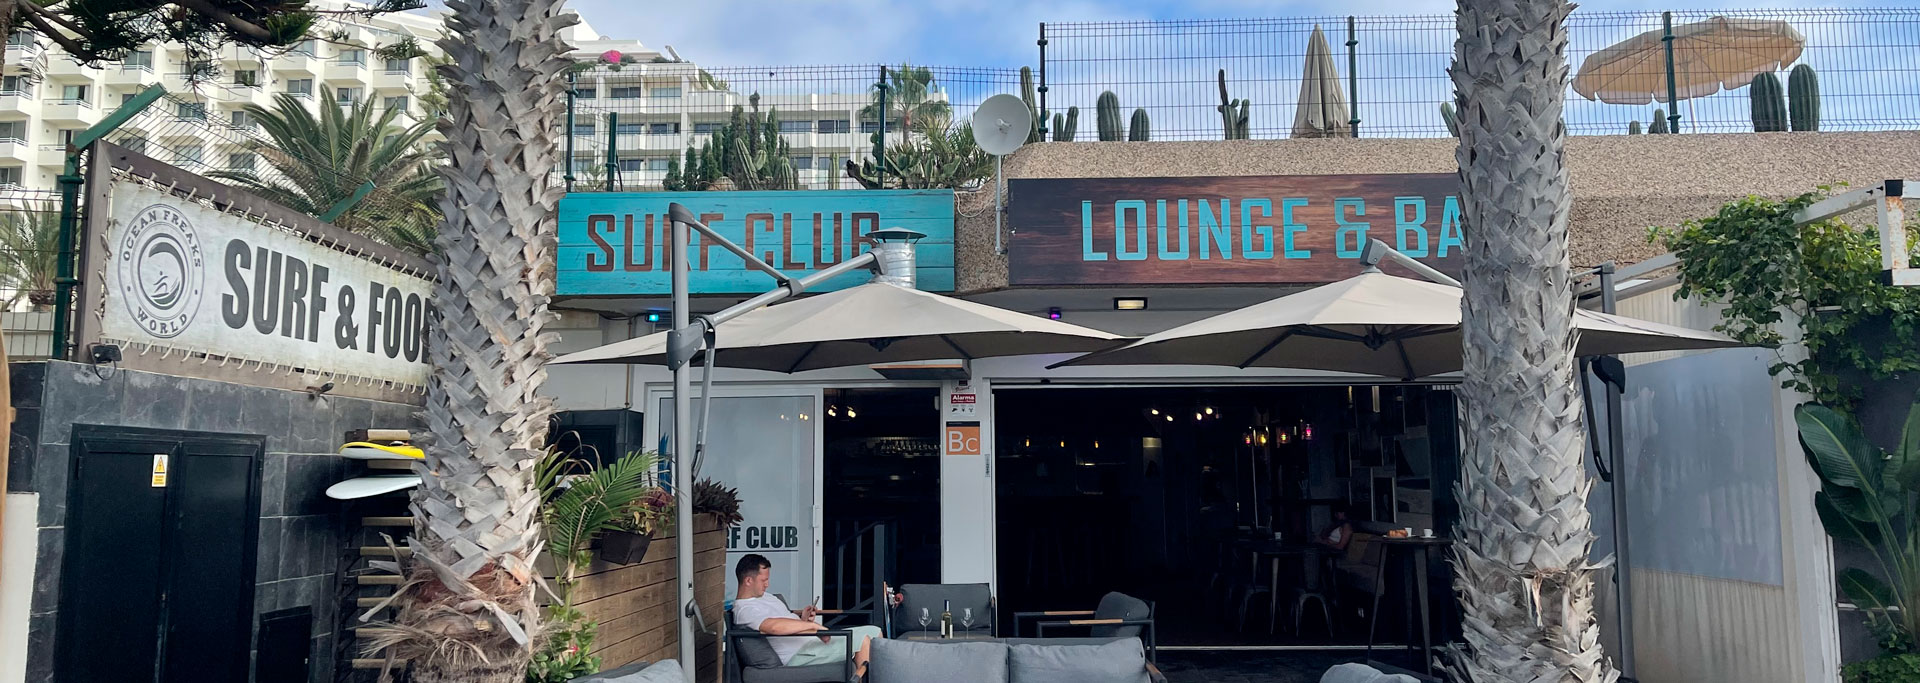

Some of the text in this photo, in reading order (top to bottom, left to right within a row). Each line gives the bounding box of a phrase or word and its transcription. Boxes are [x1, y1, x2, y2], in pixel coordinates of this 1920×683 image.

[123, 209, 201, 268] OCEAN FREAKS
[745, 211, 880, 271] CLUB
[1081, 197, 1311, 261] LOUNGE
[1334, 197, 1371, 259] &
[136, 306, 188, 334] WORLD
[221, 238, 329, 343] SURF
[334, 284, 359, 351] &
[948, 430, 978, 453] Bc
[746, 525, 798, 549] CLUB
